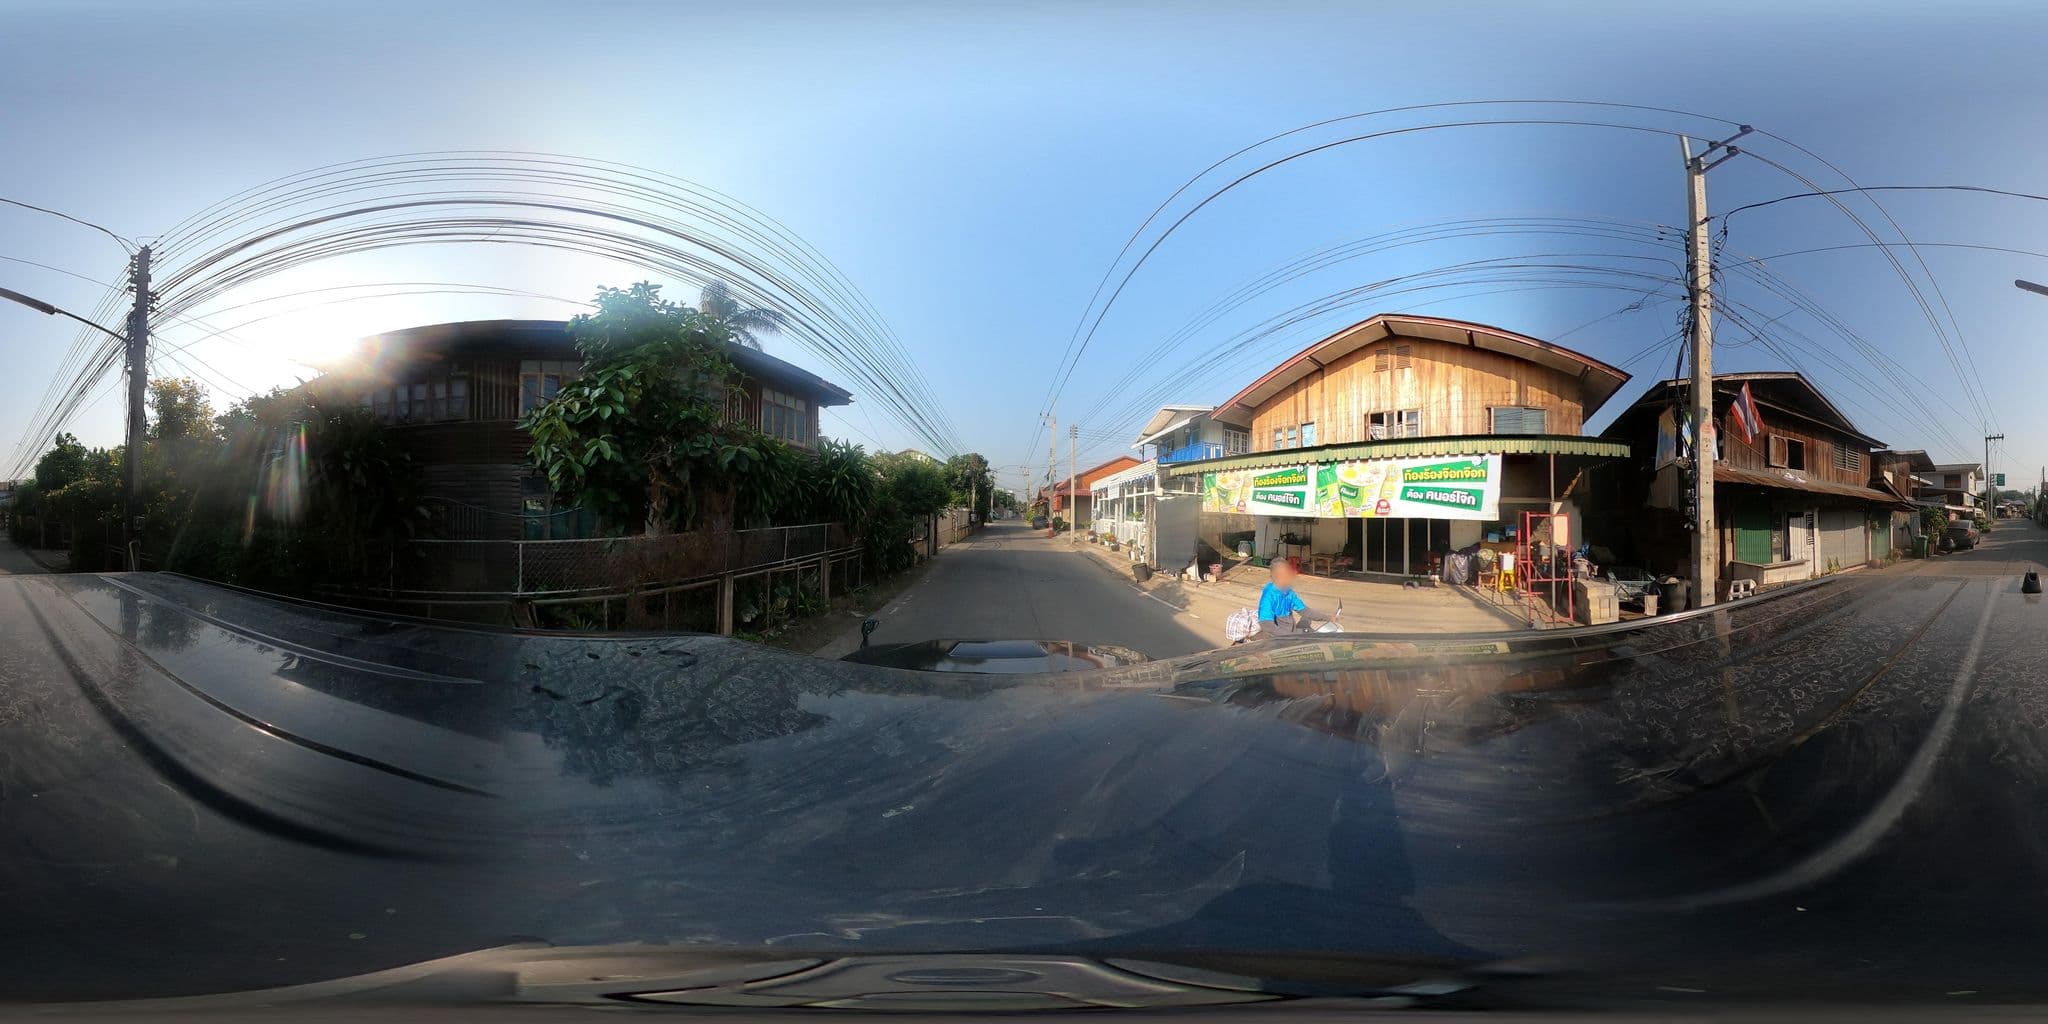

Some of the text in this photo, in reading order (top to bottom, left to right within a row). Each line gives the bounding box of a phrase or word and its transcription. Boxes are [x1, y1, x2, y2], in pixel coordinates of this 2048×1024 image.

[1404, 467, 1486, 481] ท้องร้องจ๊อกจ๊อก
[1406, 489, 1424, 499] ต้อง
